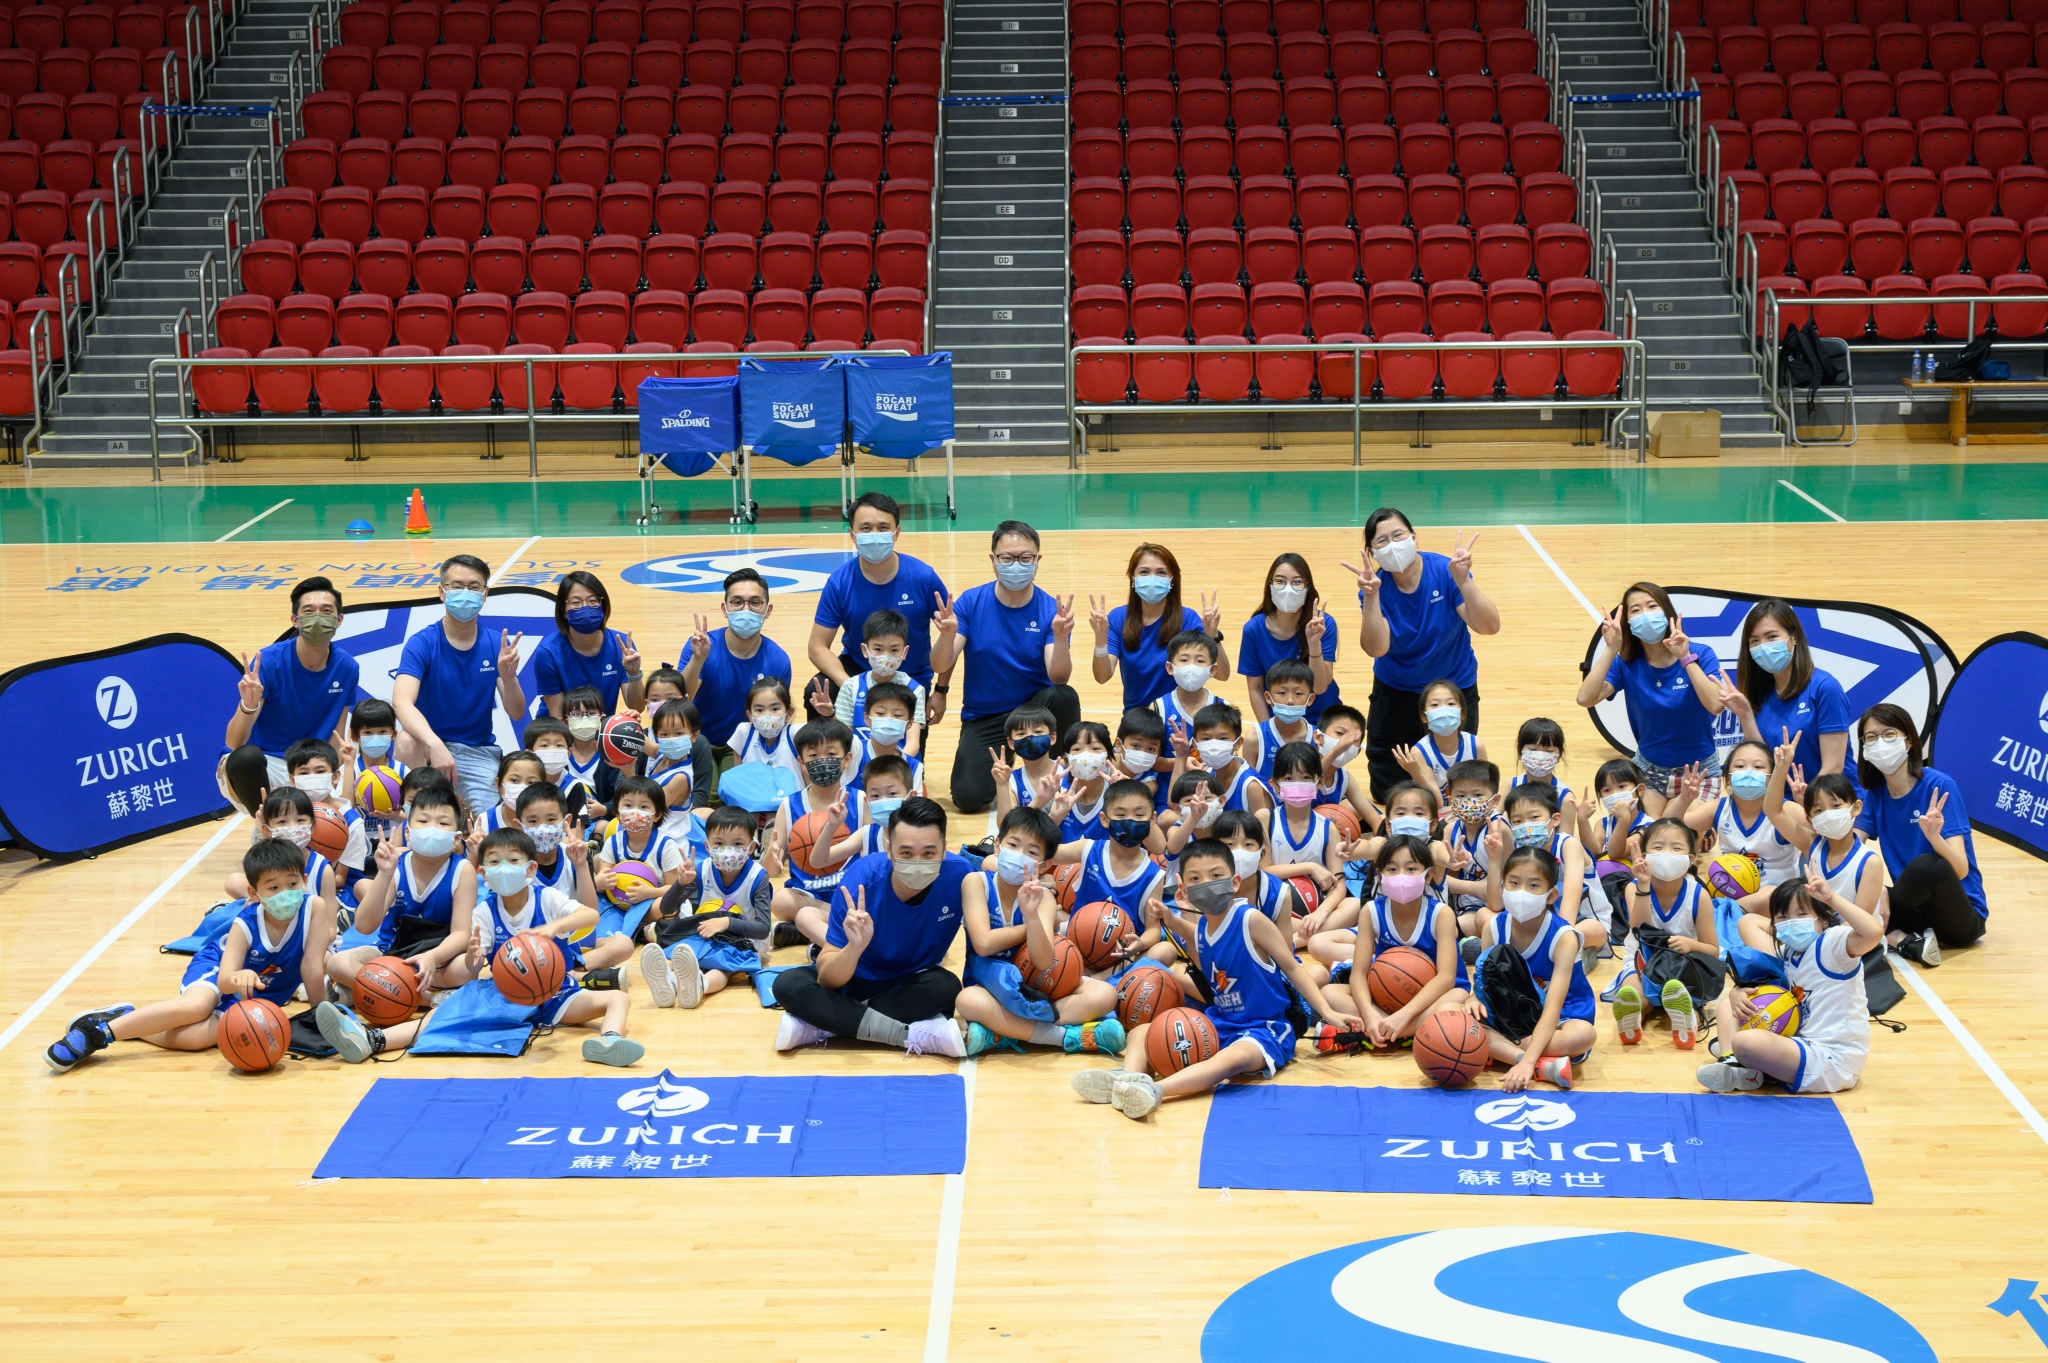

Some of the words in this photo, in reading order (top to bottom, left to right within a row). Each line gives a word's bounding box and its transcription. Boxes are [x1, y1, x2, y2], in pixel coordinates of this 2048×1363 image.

[772, 403, 814, 413] POCARI
[875, 402, 913, 411] SWEAT
[876, 395, 917, 404] POCARI
[661, 416, 711, 429] SPALDING
[773, 410, 810, 419] SWEAT
[75, 564, 299, 574] STADIUM
[76, 732, 189, 787] ZURICH
[1991, 735, 2048, 783] ZURI
[106, 777, 177, 820] 蘇黎世
[1995, 782, 2048, 827] 蘇黎世
[360, 968, 403, 998] SPALDING
[506, 1120, 796, 1146] ZURICH
[569, 1150, 713, 1170] 蘇黎世
[1380, 1136, 1679, 1164] ZURICH
[1457, 1168, 1605, 1188] 蘇黎世
